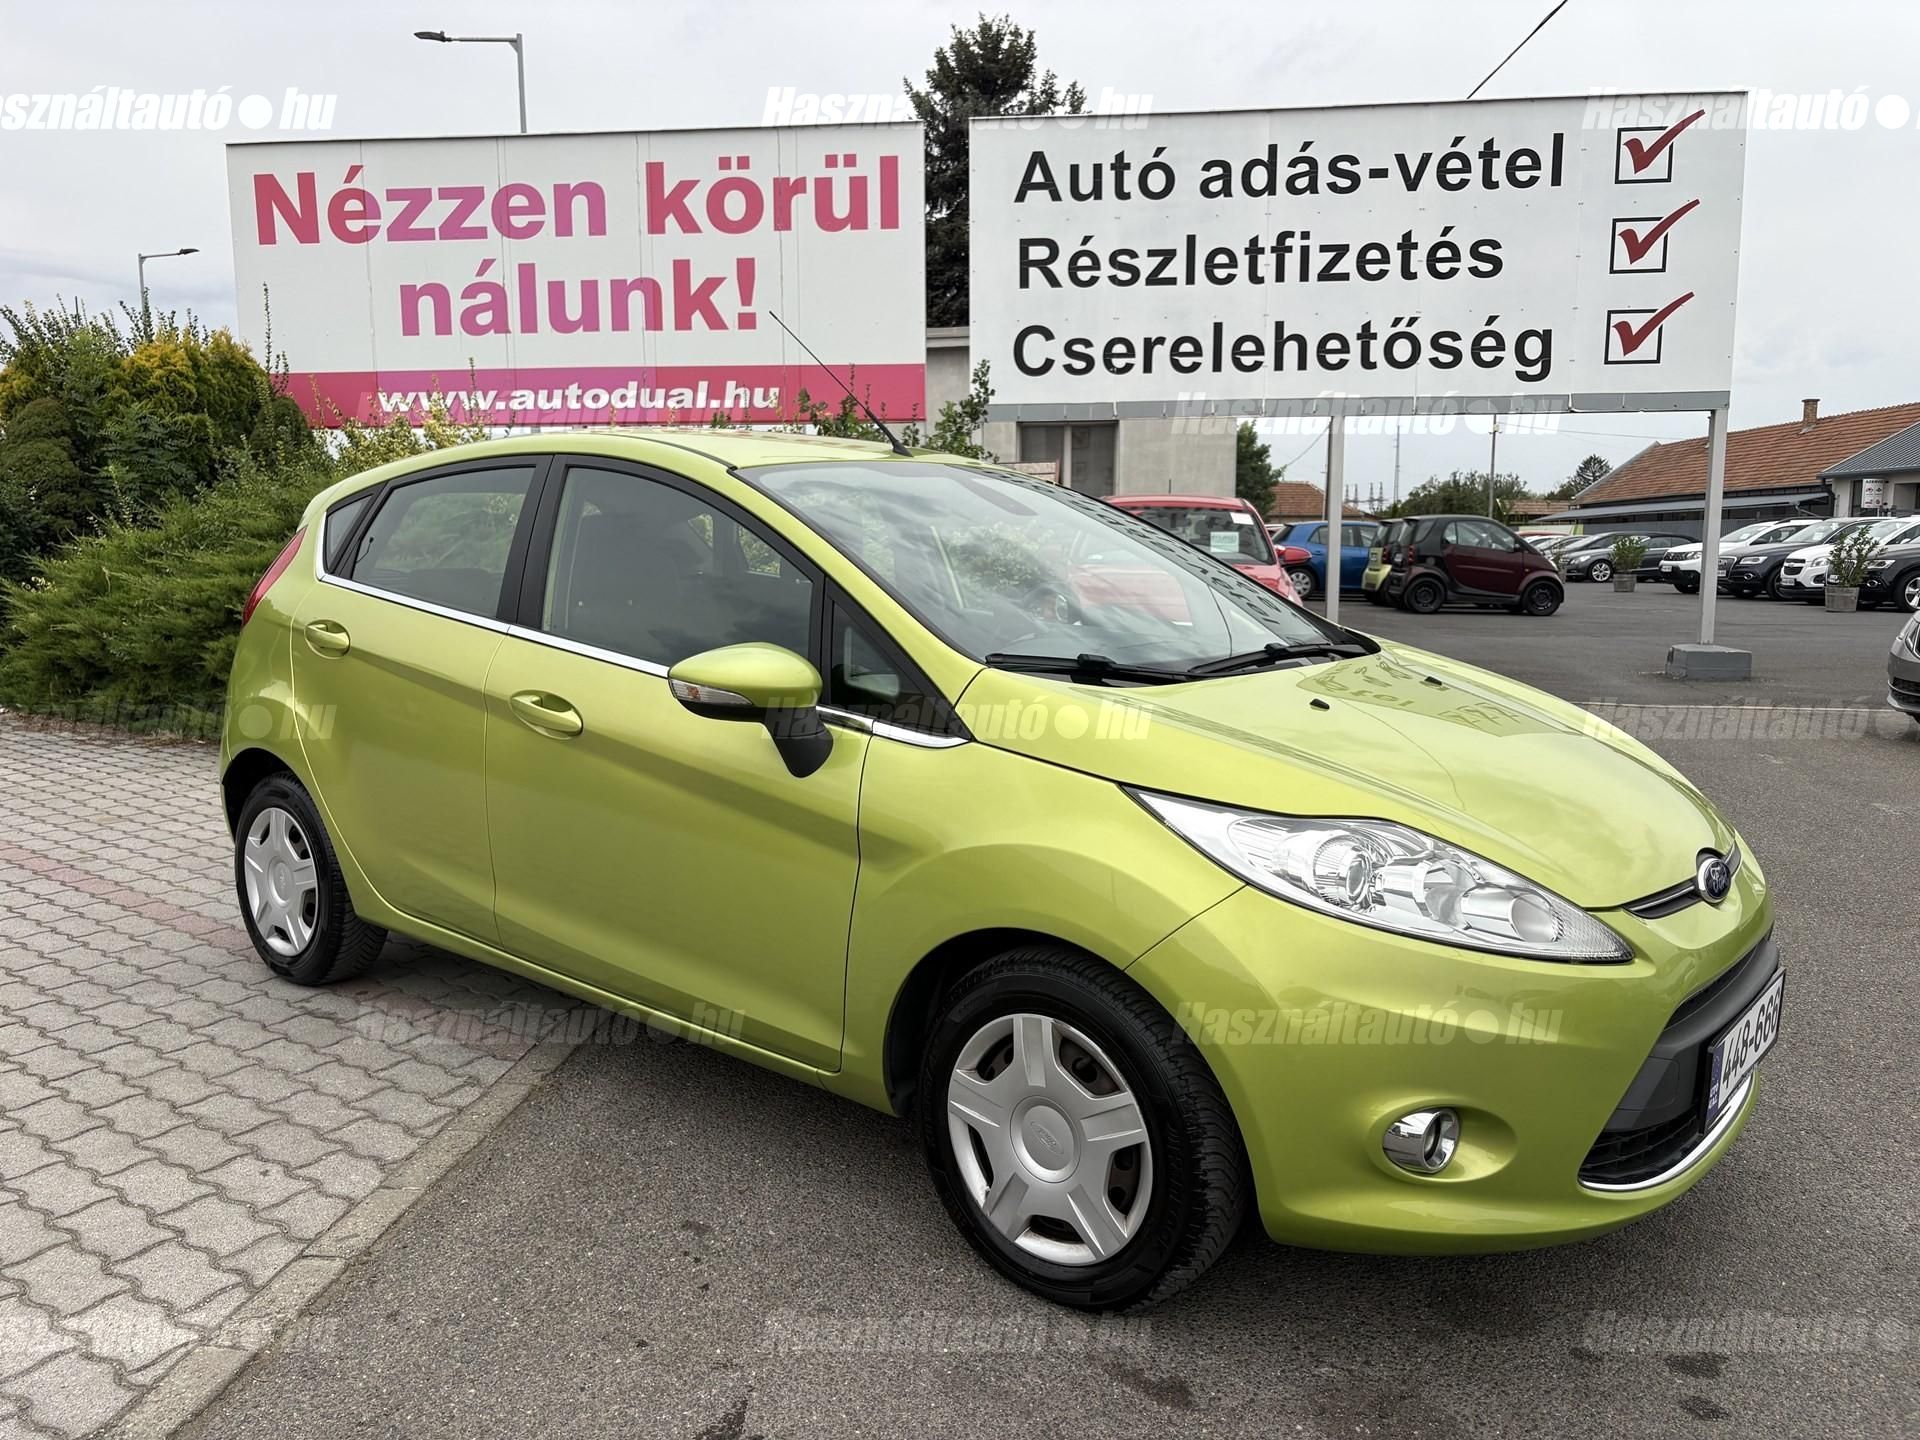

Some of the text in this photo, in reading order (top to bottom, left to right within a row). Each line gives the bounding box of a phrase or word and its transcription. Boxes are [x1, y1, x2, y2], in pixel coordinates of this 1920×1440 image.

[254, 154, 898, 244] Nézzen körül
[1015, 133, 1563, 202] Autó adás-vétel
[1020, 226, 1503, 288] Részletfizetés
[401, 258, 756, 336] nálunk!
[1014, 315, 1552, 382] Cserelehetőség
[378, 381, 779, 413] www.autodual.hu
[1722, 986, 1781, 1089] 448-666
